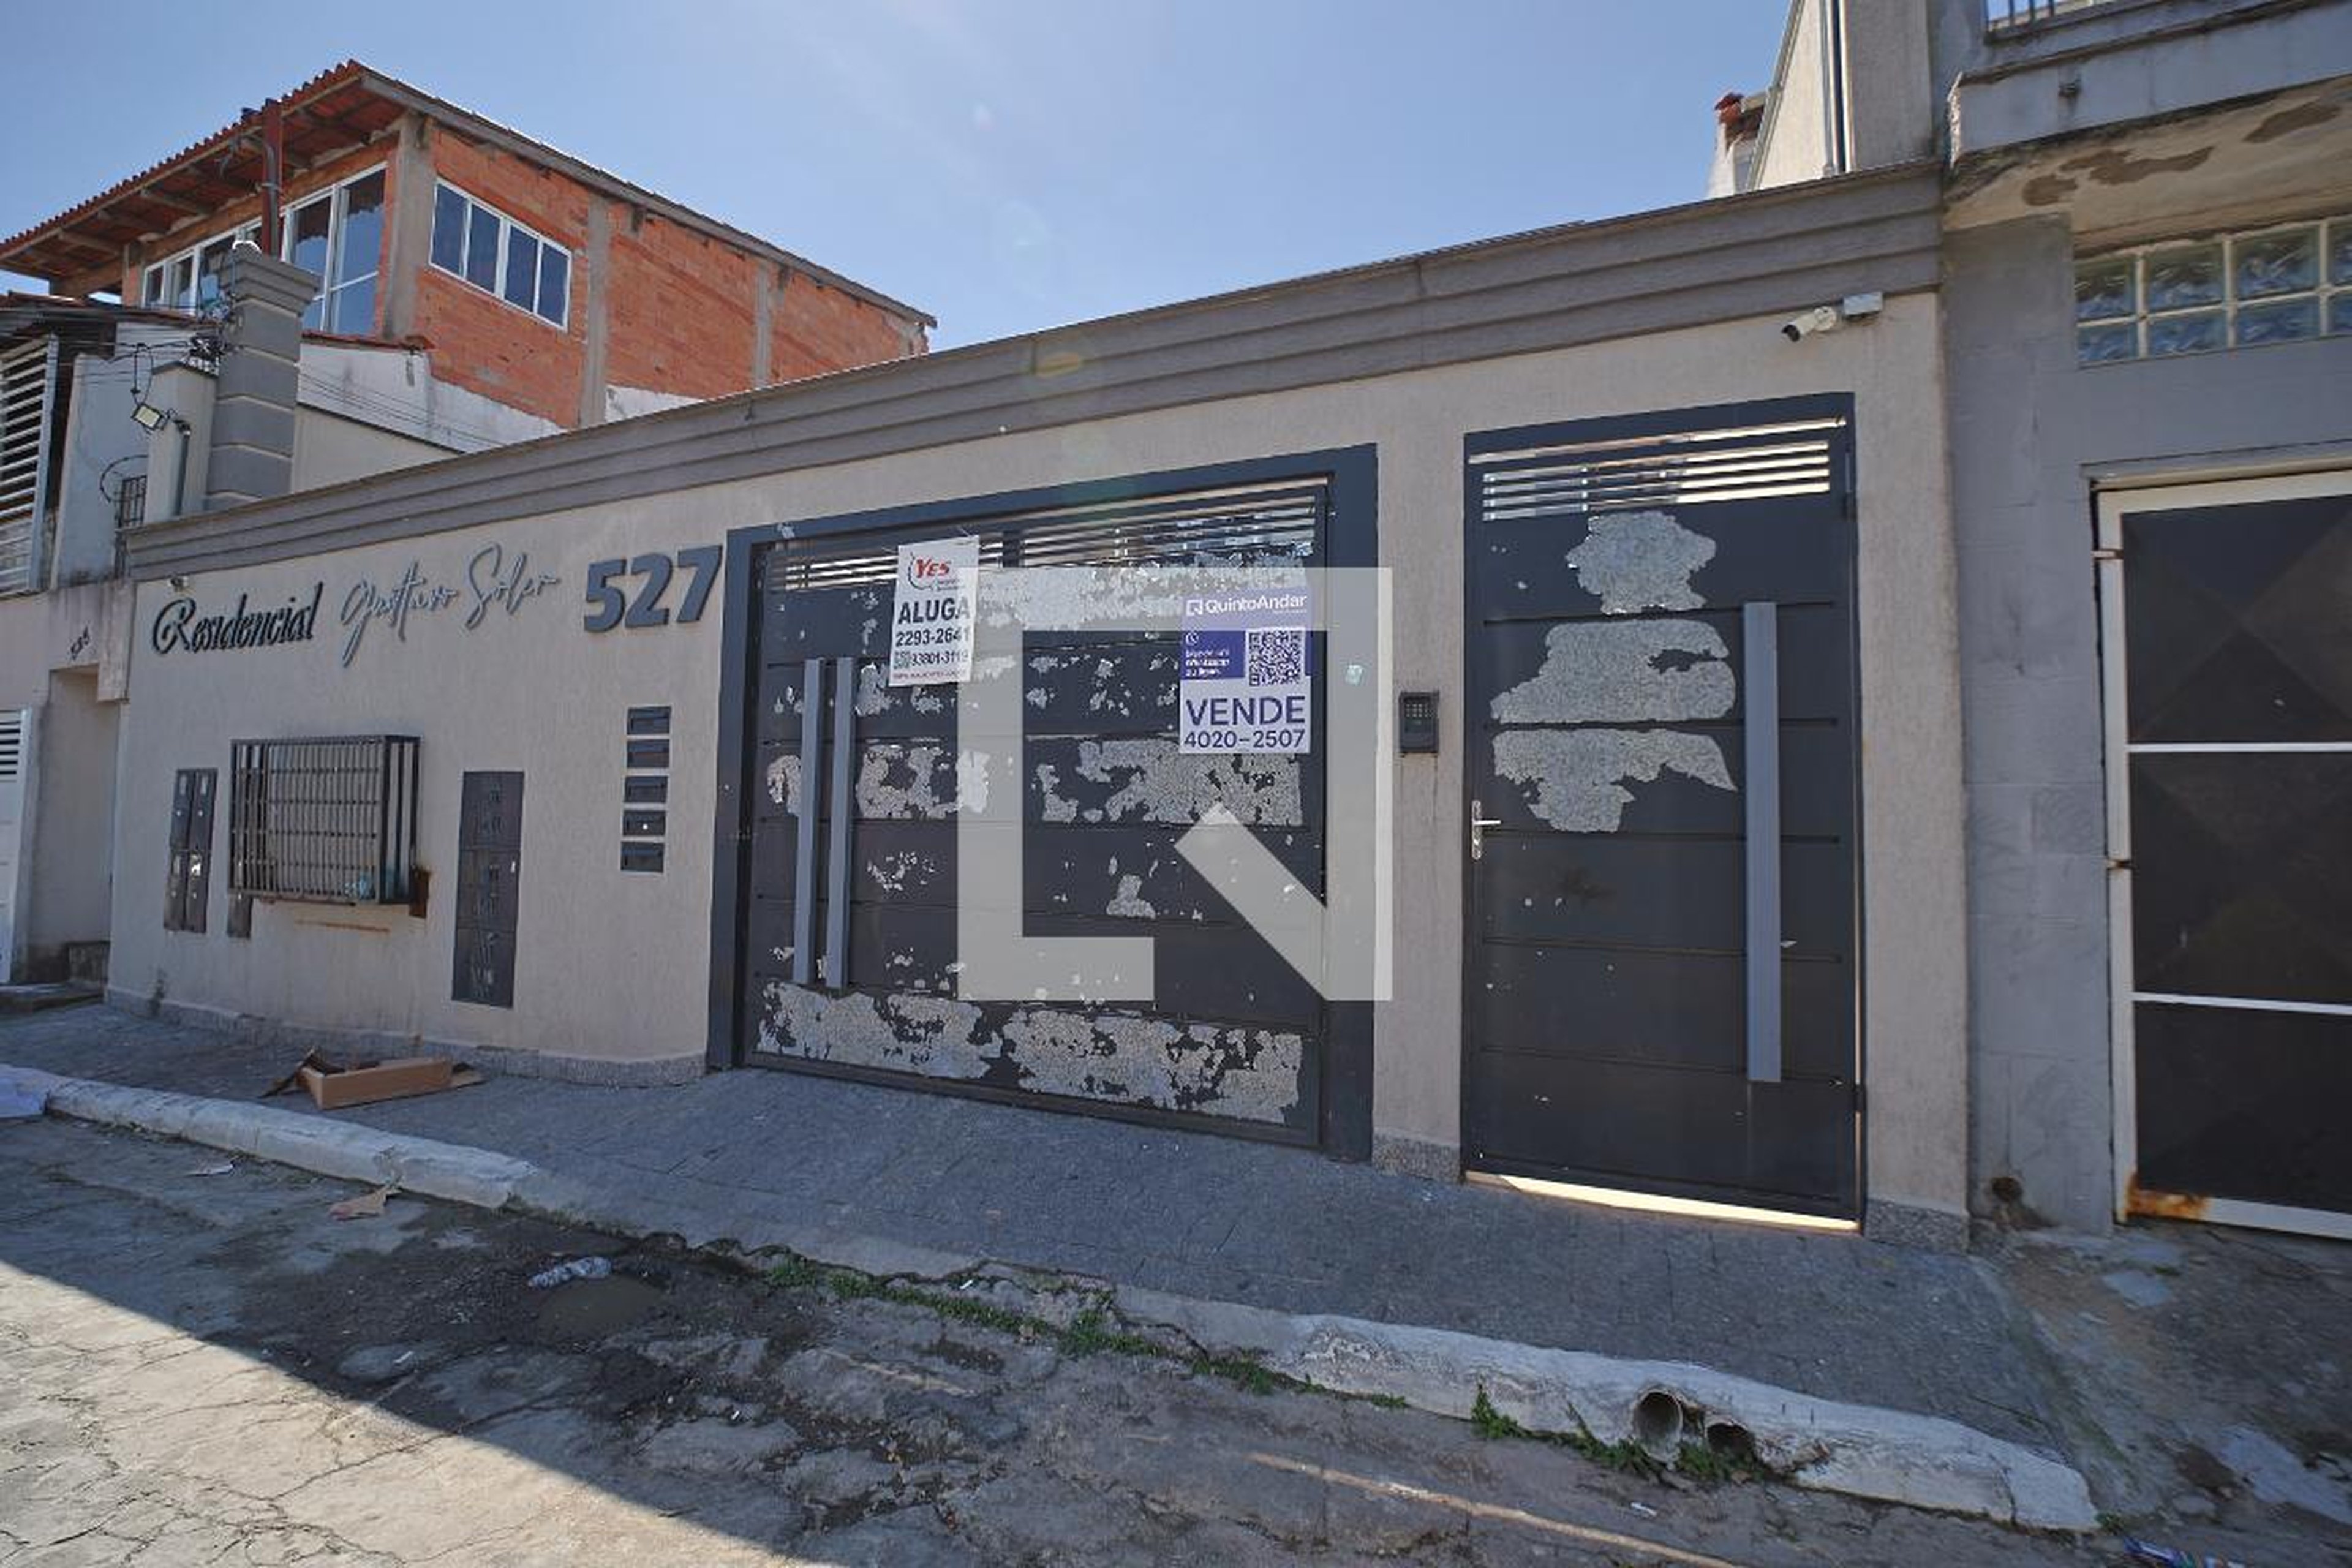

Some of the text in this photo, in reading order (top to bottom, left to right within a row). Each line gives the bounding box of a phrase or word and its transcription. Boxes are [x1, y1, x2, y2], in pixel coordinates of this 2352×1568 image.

[584, 544, 723, 633] 527
[152, 581, 324, 655] Residencial
[897, 597, 971, 625] ALUGA
[1205, 594, 1308, 614] QuintoAndar
[1185, 695, 1306, 726] VENDE
[1184, 729, 1306, 748] 4020-2507
